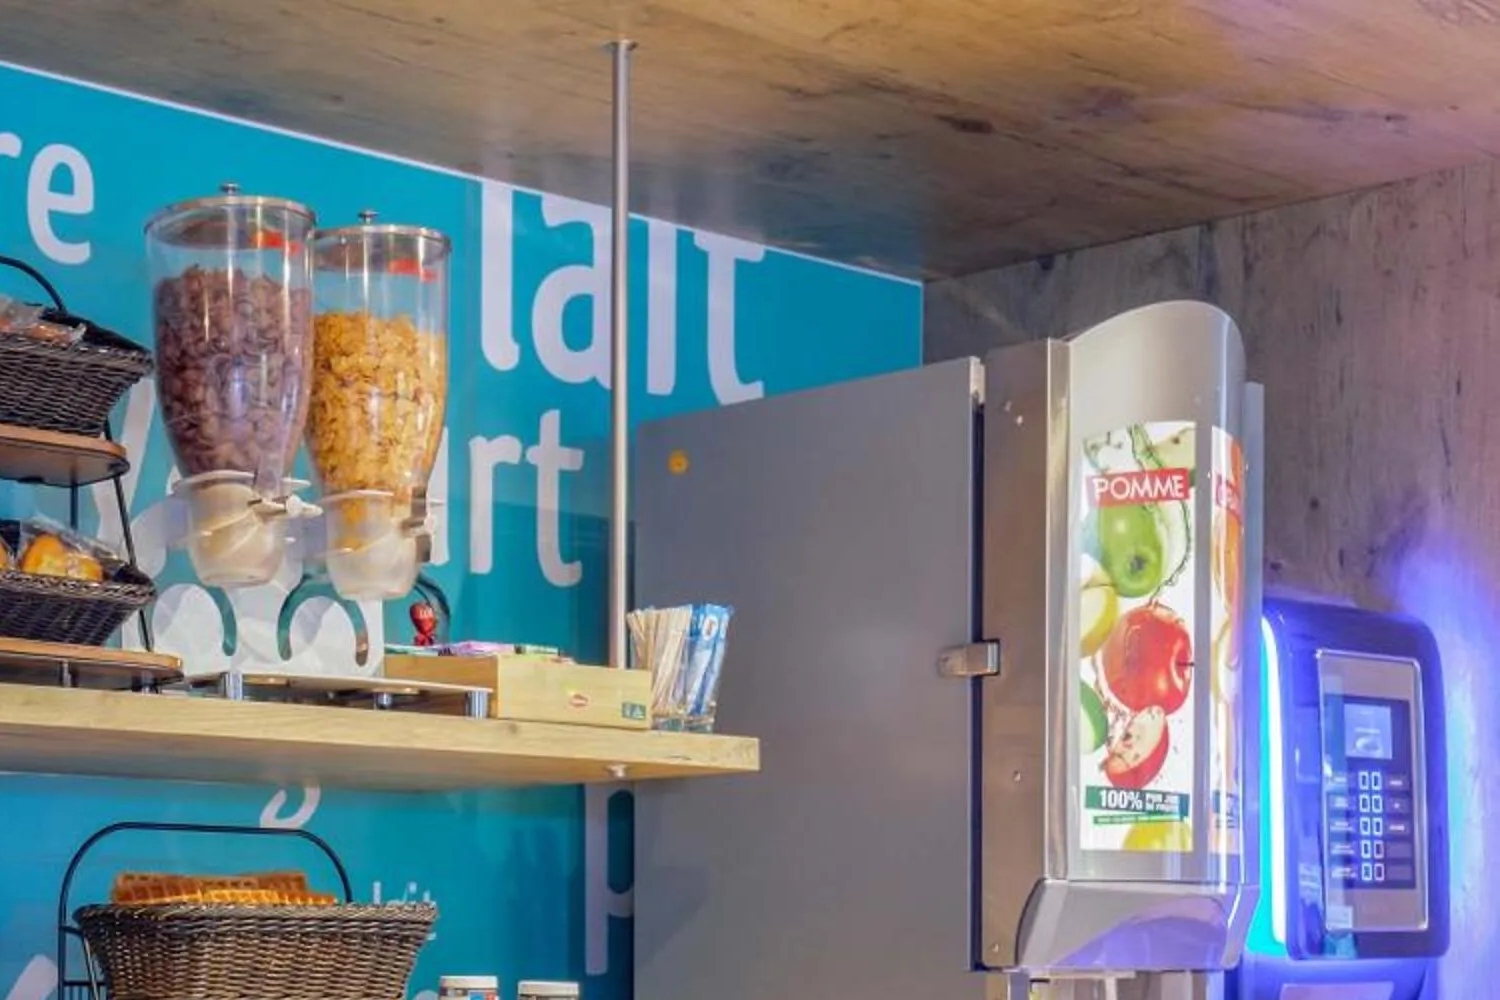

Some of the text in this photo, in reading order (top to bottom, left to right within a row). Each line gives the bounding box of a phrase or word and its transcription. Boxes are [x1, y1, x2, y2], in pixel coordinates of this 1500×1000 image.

[481, 181, 764, 406] lait
[1093, 474, 1185, 500] POMME
[1100, 789, 1143, 811] 100%
